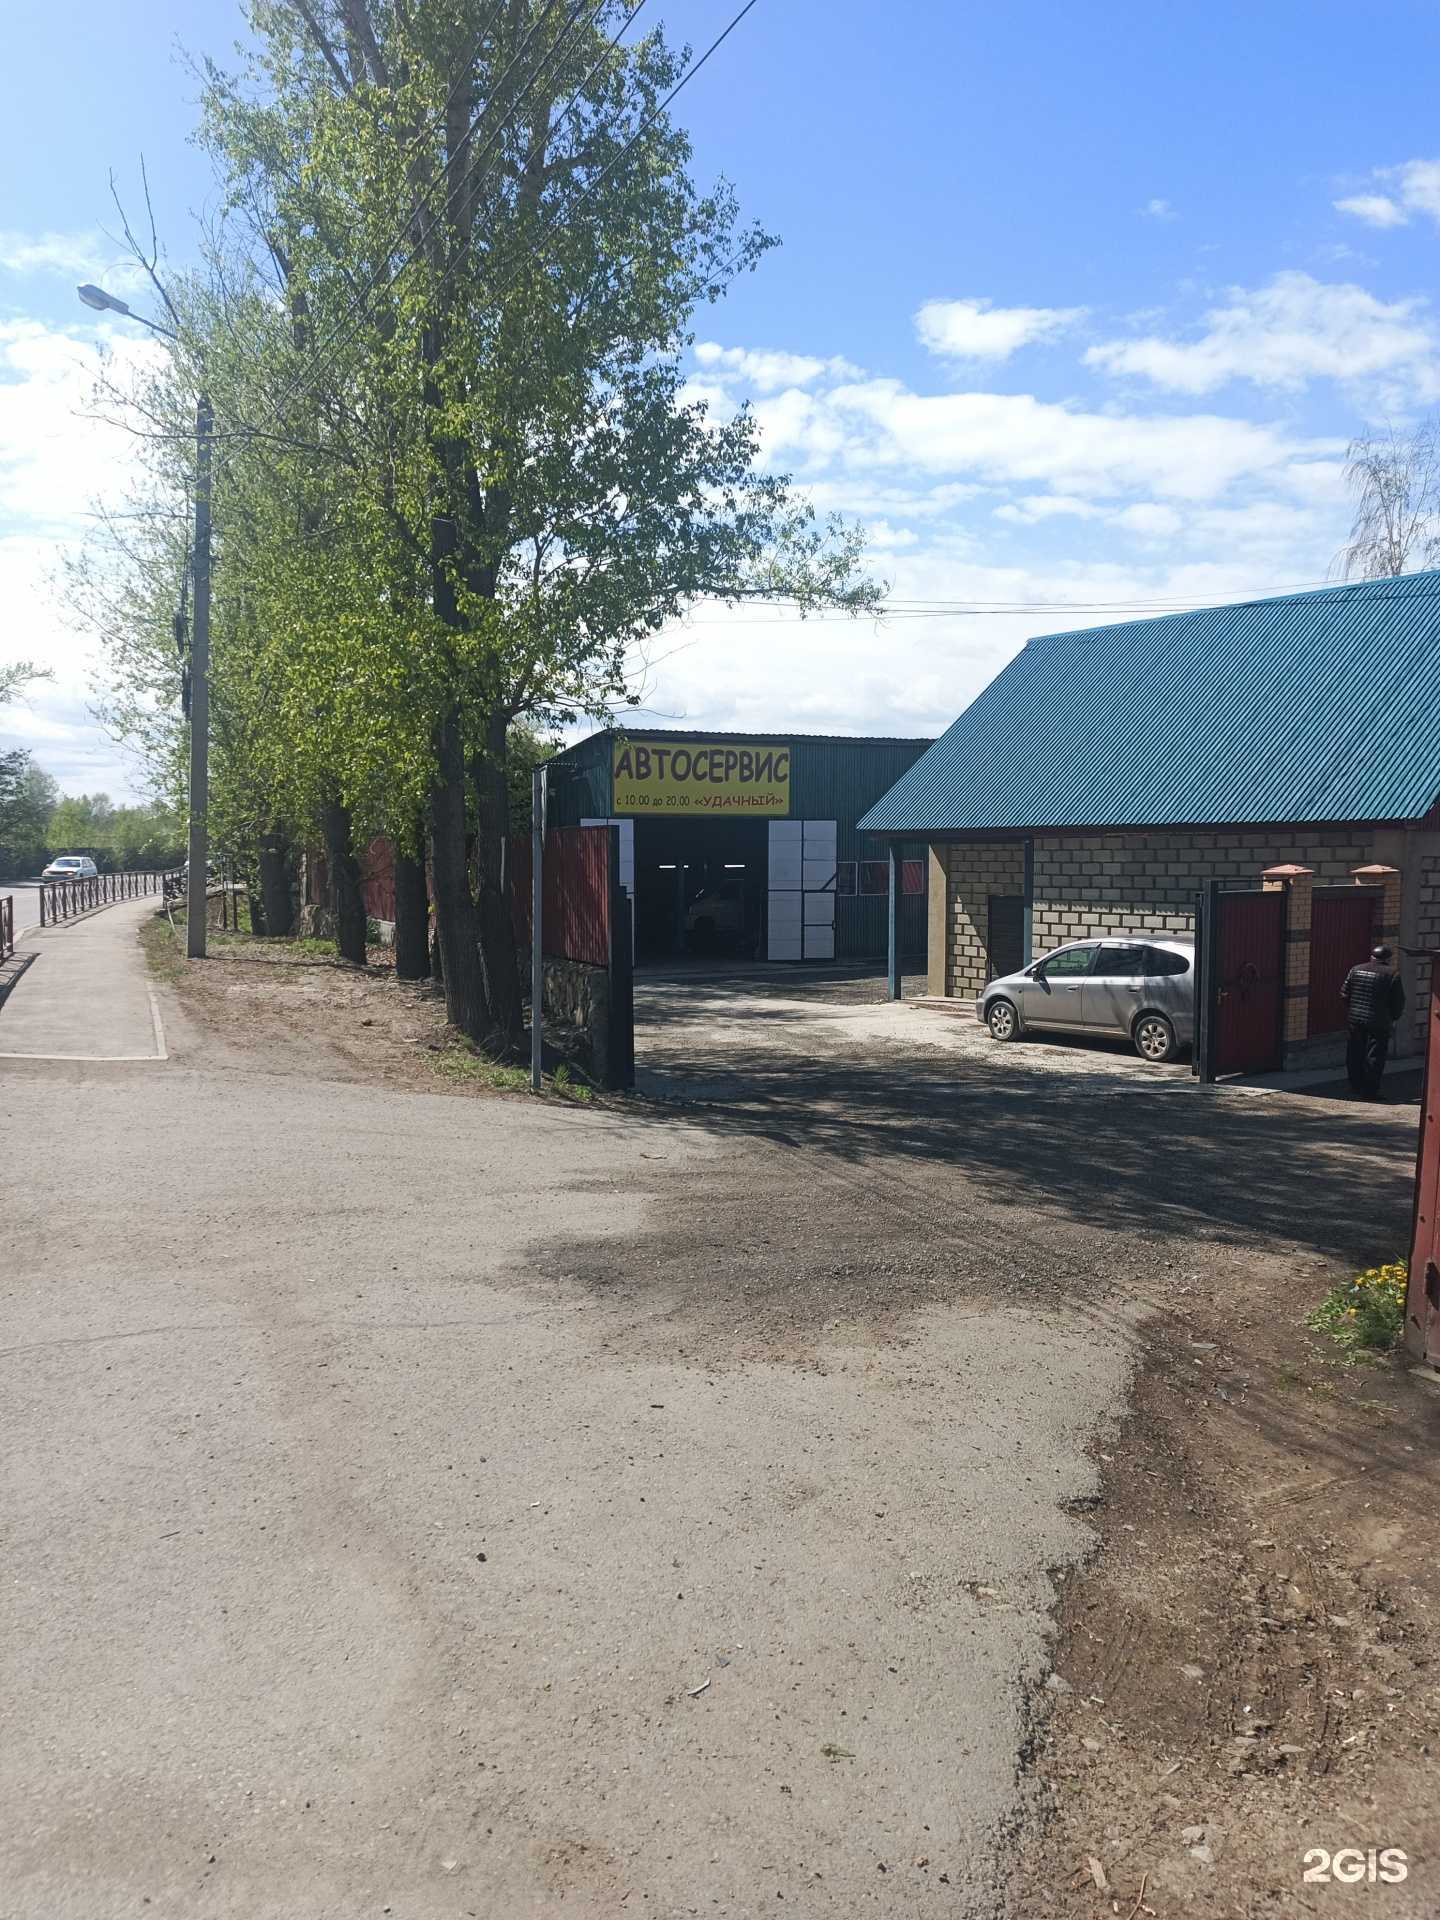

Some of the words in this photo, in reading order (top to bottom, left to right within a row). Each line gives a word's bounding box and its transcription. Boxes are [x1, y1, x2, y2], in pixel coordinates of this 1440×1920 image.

[614, 746, 789, 784] АВТОСЕРВИС
[616, 797, 621, 805] с
[653, 797, 663, 807] до
[694, 793, 784, 808] «УДАЧНЫЙ»
